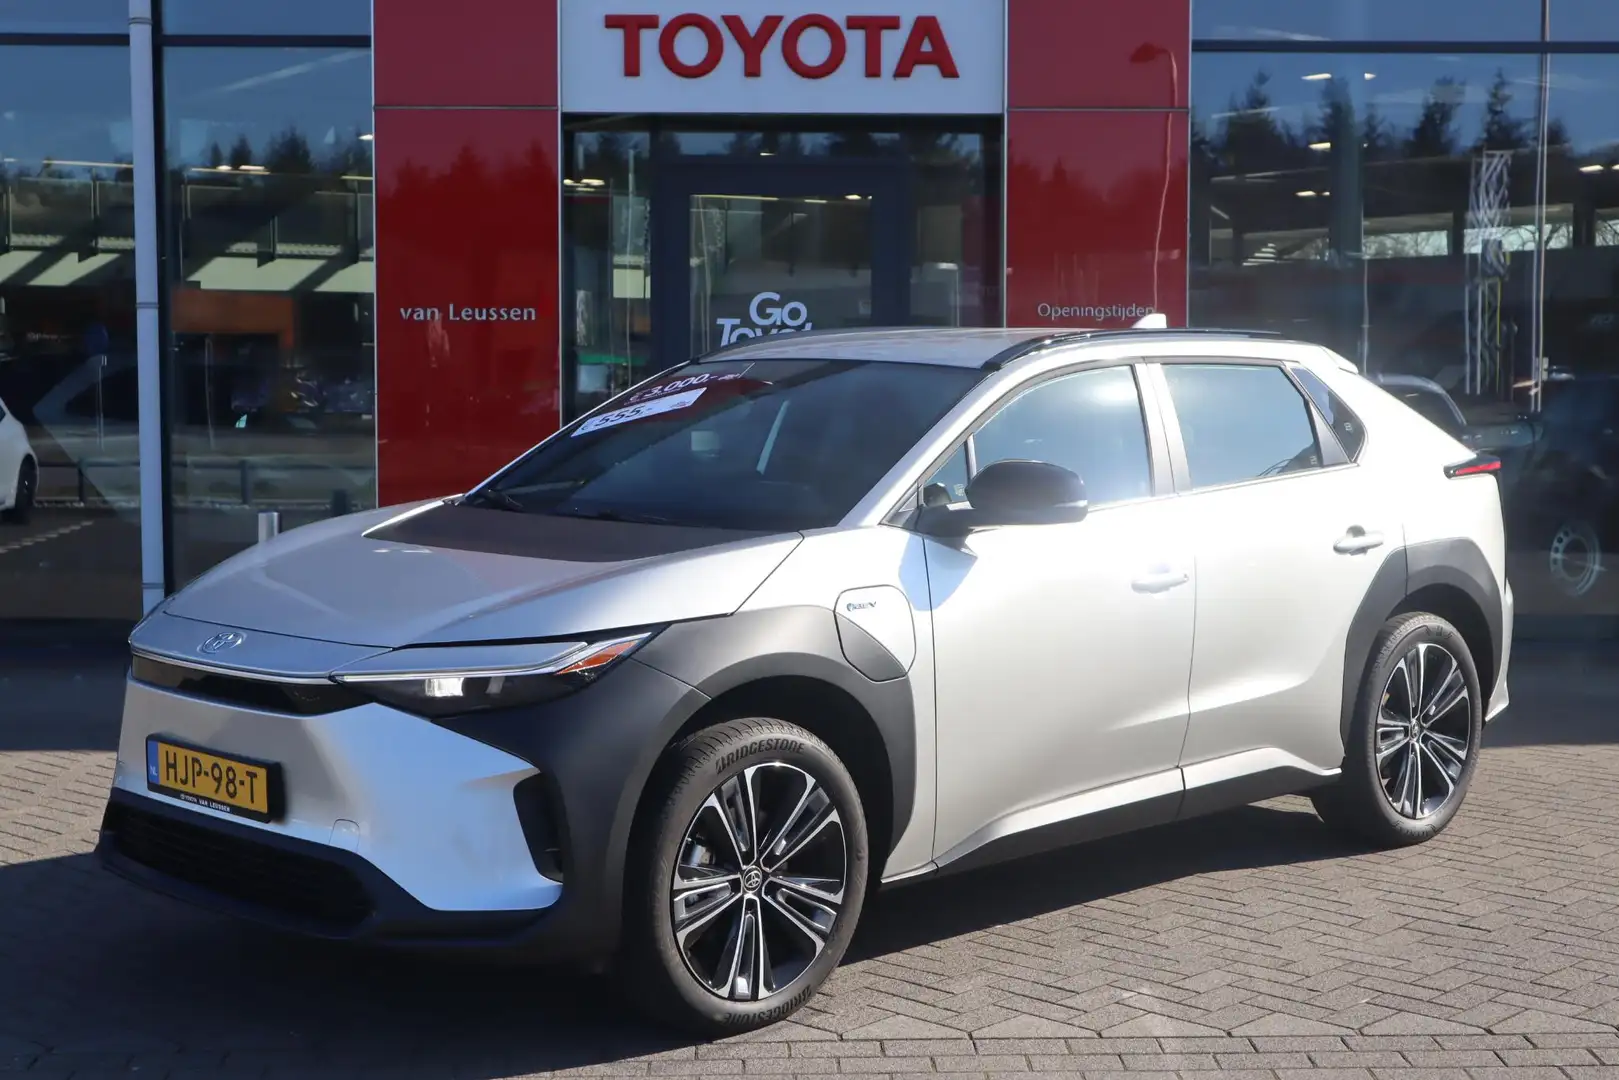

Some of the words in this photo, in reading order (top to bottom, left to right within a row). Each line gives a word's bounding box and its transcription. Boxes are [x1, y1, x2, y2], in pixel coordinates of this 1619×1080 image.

[605, 13, 960, 79] TOYOTA
[400, 307, 439, 320] van
[449, 303, 536, 321] Leussen
[749, 291, 807, 327] Go
[149, 765, 158, 776] NL
[715, 738, 806, 775] BRIDGESTONE
[165, 750, 258, 804] HJP-98-T
